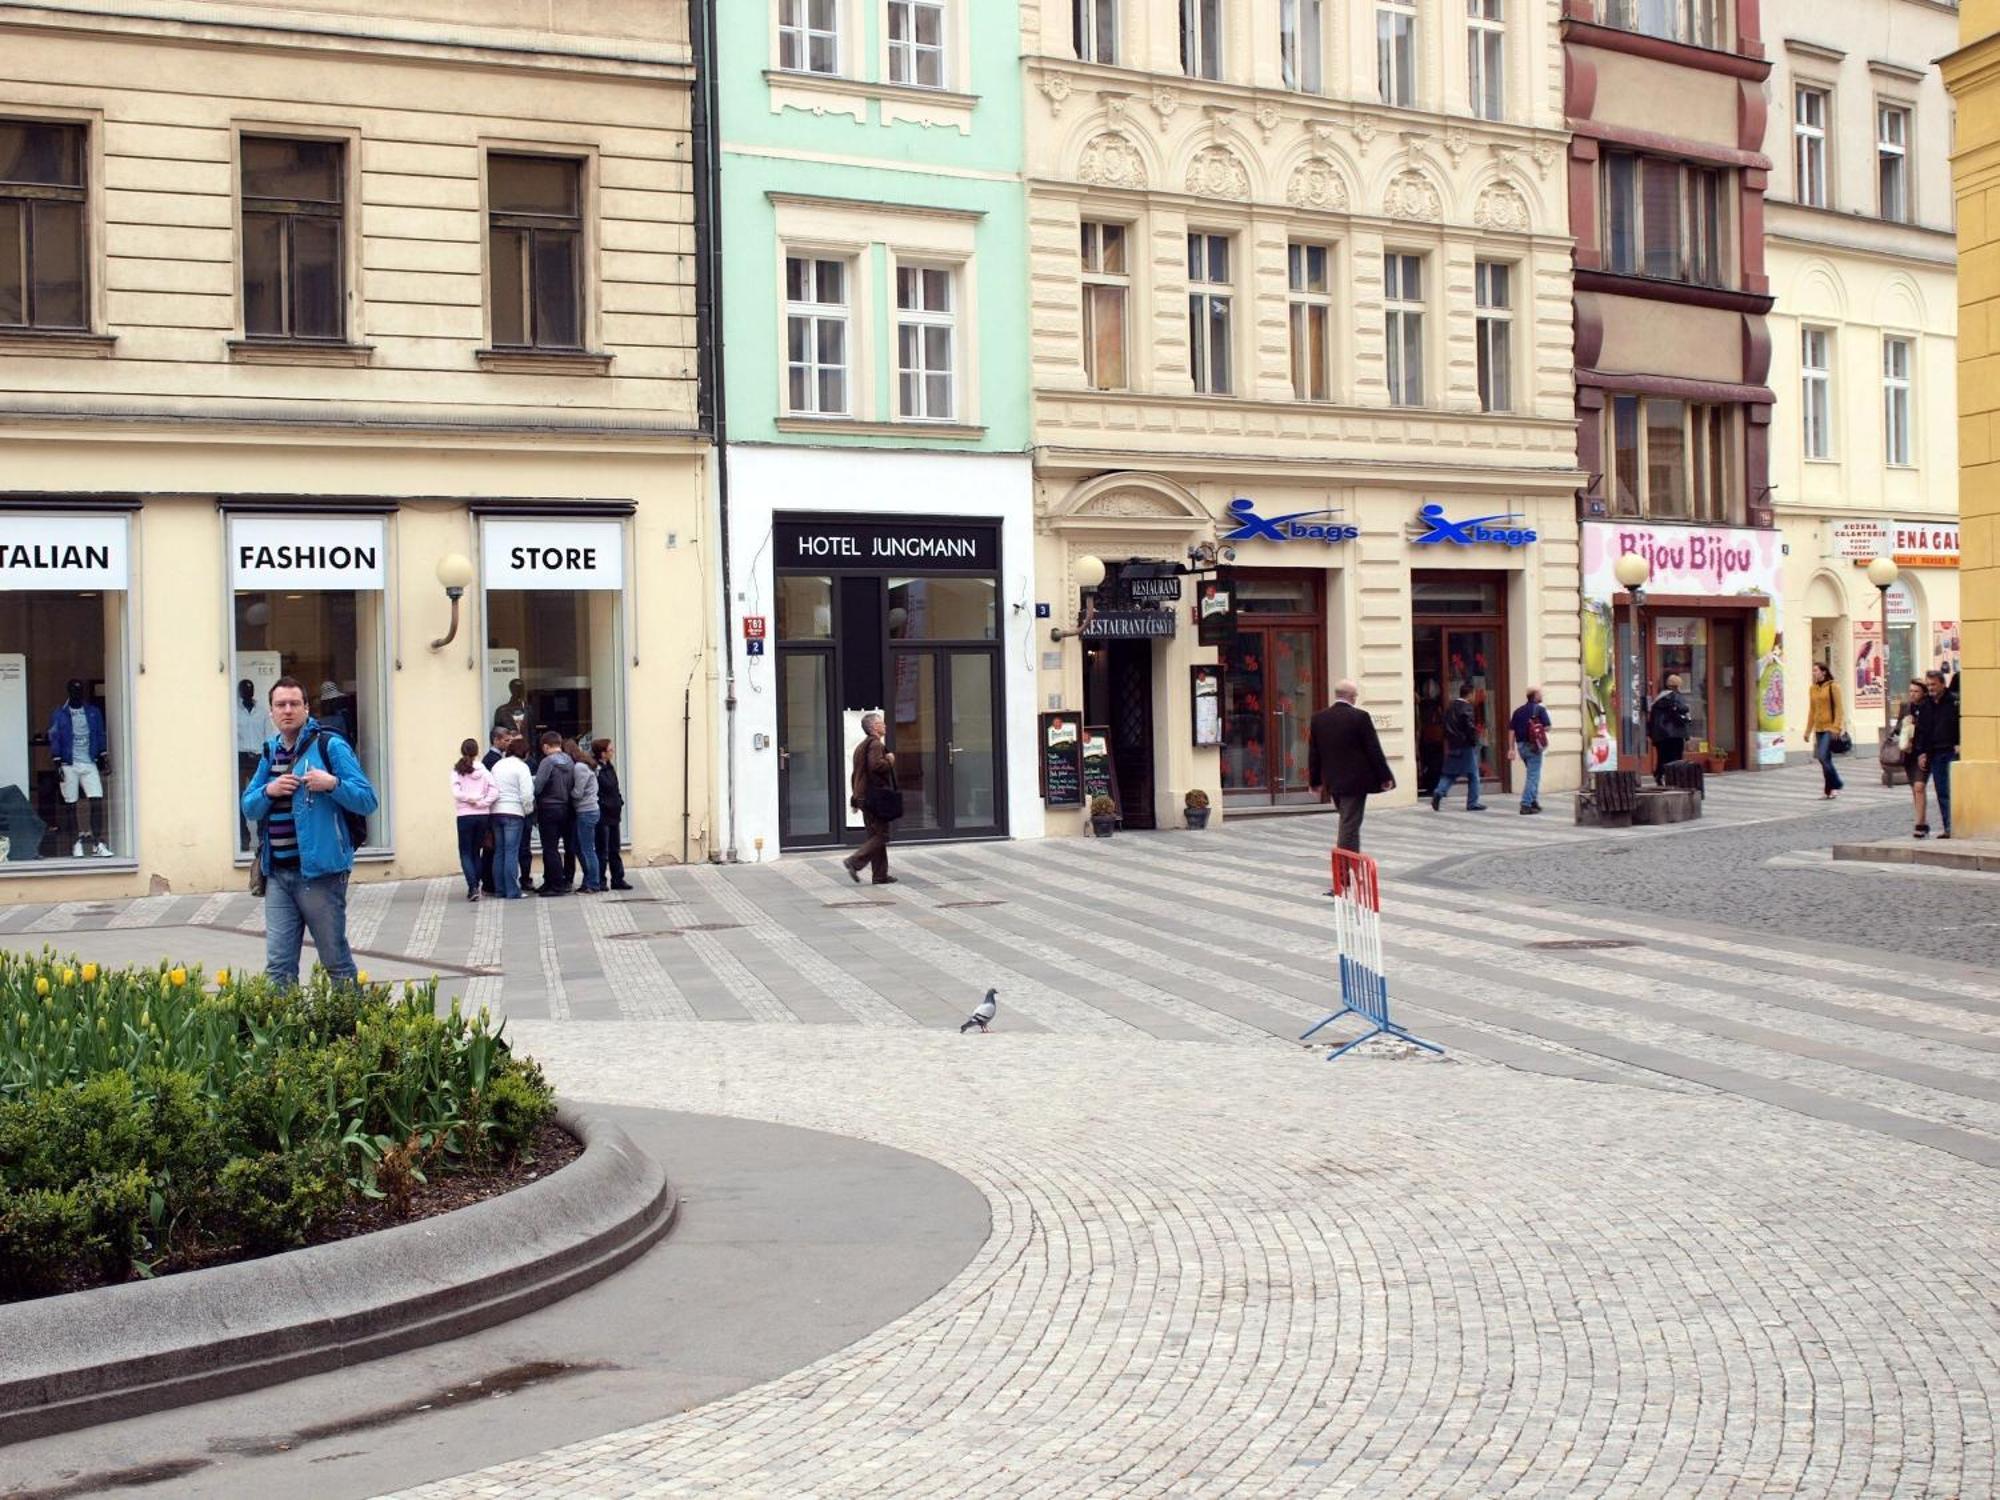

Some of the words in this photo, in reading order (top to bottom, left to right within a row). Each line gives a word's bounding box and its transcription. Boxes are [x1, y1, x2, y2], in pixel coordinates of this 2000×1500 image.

[240, 546, 376, 569] FASHION
[799, 536, 861, 556] HOTEL
[871, 537, 976, 557] JUNGMANN
[510, 547, 596, 570] STORE
[1690, 536, 1751, 584] Bijou
[1132, 580, 1179, 595] RESTAURANT
[753, 642, 759, 652] 2
